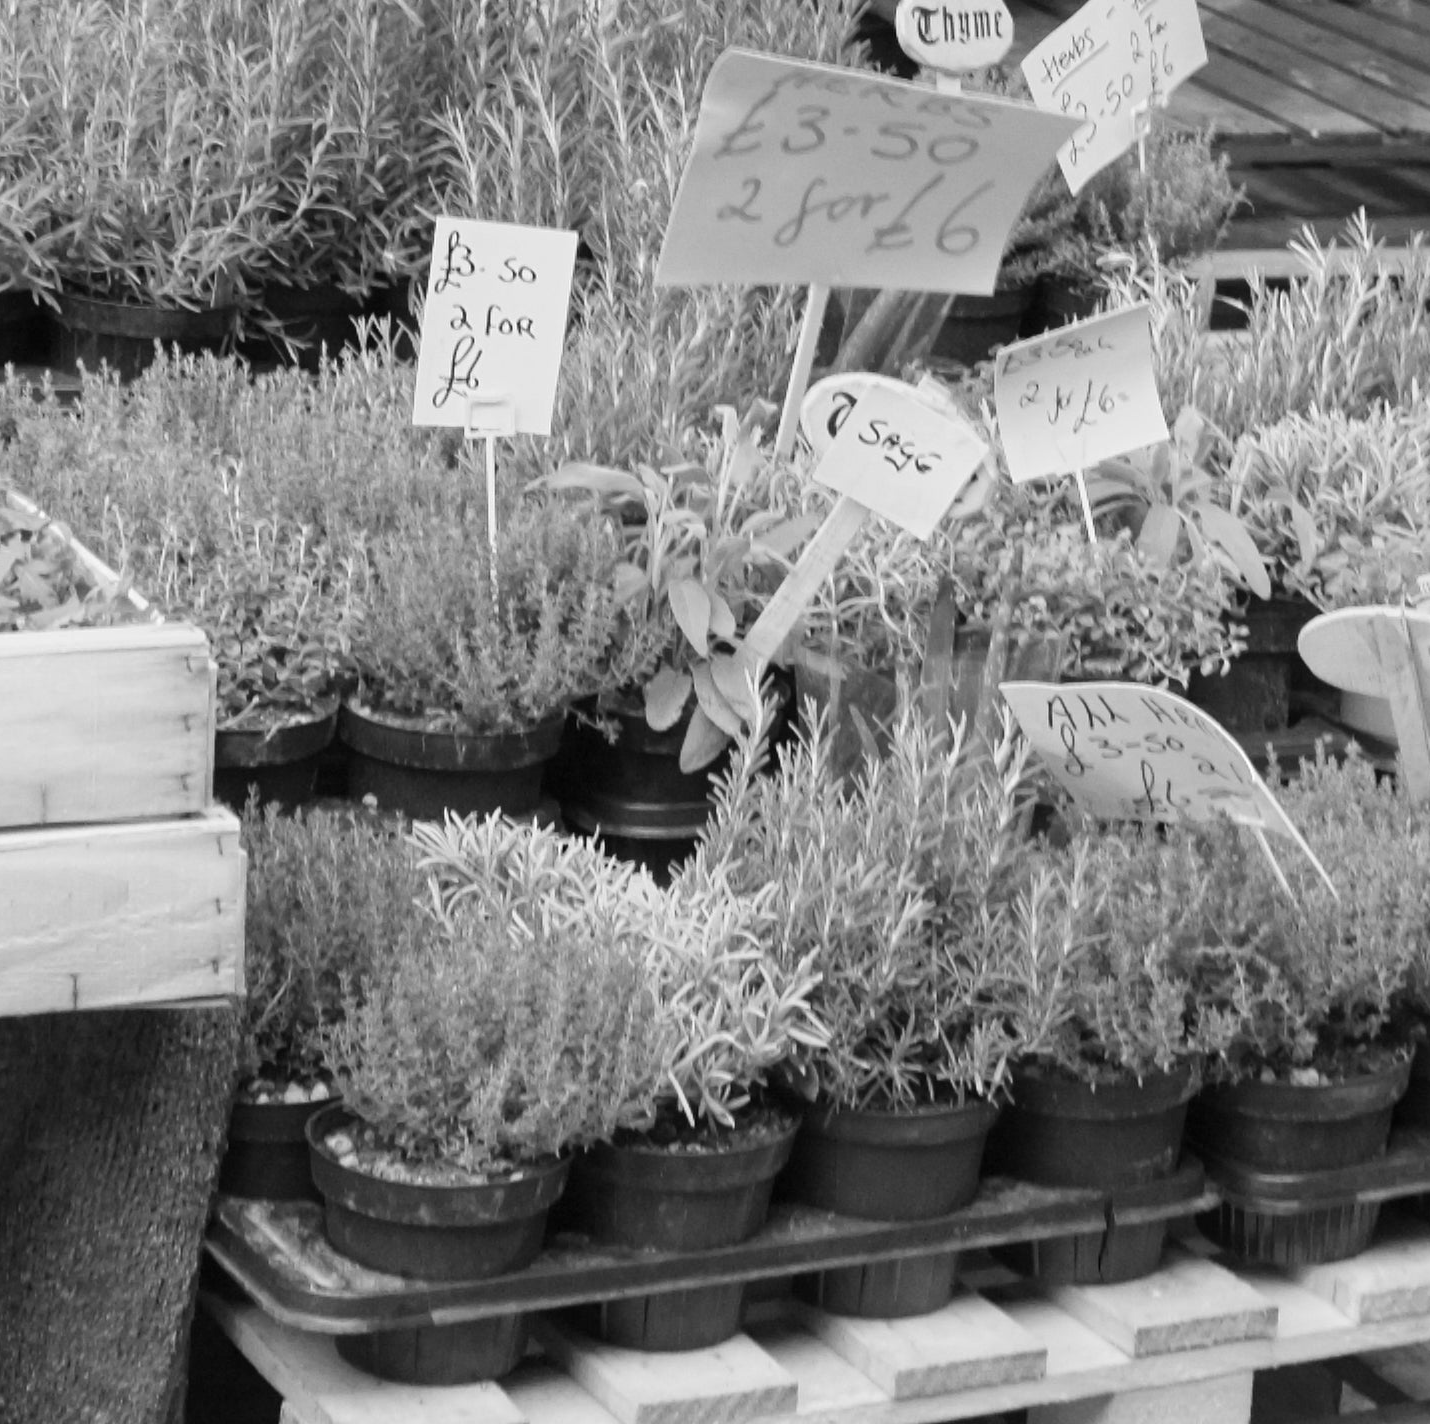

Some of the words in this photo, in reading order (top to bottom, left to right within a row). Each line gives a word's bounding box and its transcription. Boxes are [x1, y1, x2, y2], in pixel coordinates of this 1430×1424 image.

[911, 5, 1004, 47] Thyme
[716, 177, 763, 223] 2
[773, 176, 891, 248] for
[865, 172, 997, 257] £6
[449, 303, 474, 332] 2
[432, 334, 484, 409] £6
